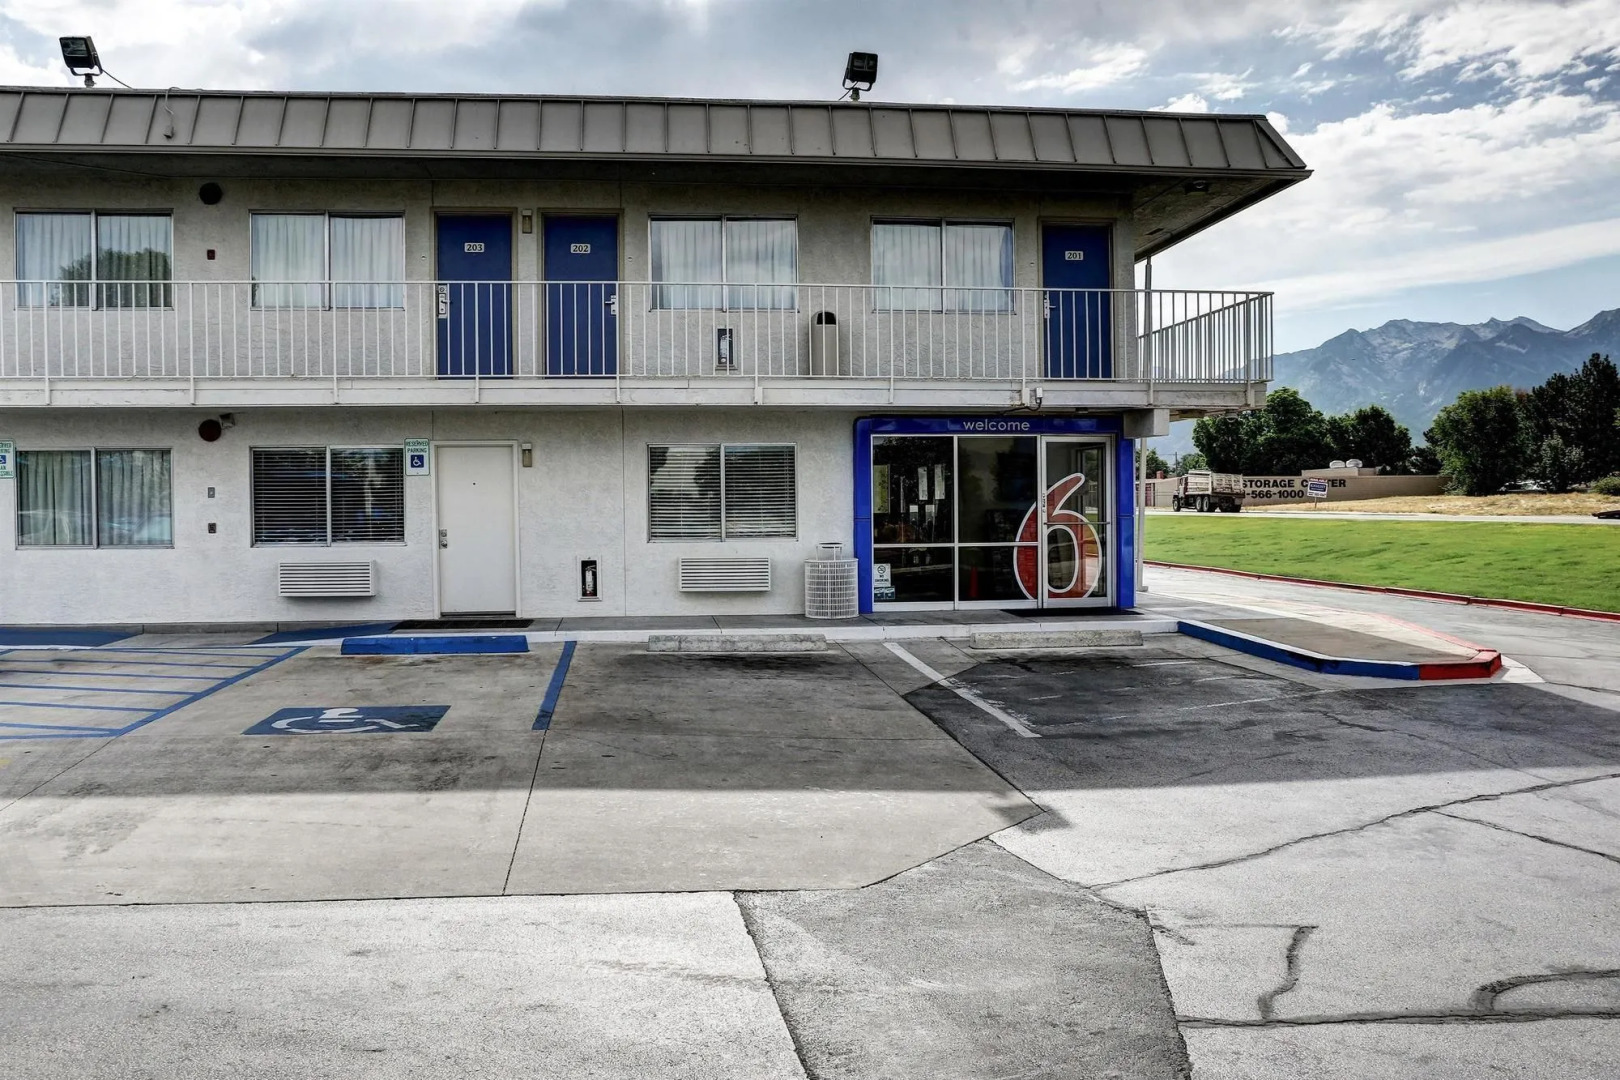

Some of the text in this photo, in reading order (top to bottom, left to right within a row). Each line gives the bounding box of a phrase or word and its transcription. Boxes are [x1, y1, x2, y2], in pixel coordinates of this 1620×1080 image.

[963, 419, 1030, 430] welcome
[1242, 479, 1294, 488] STORAGE
[1301, 479, 1346, 488] CTER
[1013, 472, 1102, 600] 6
